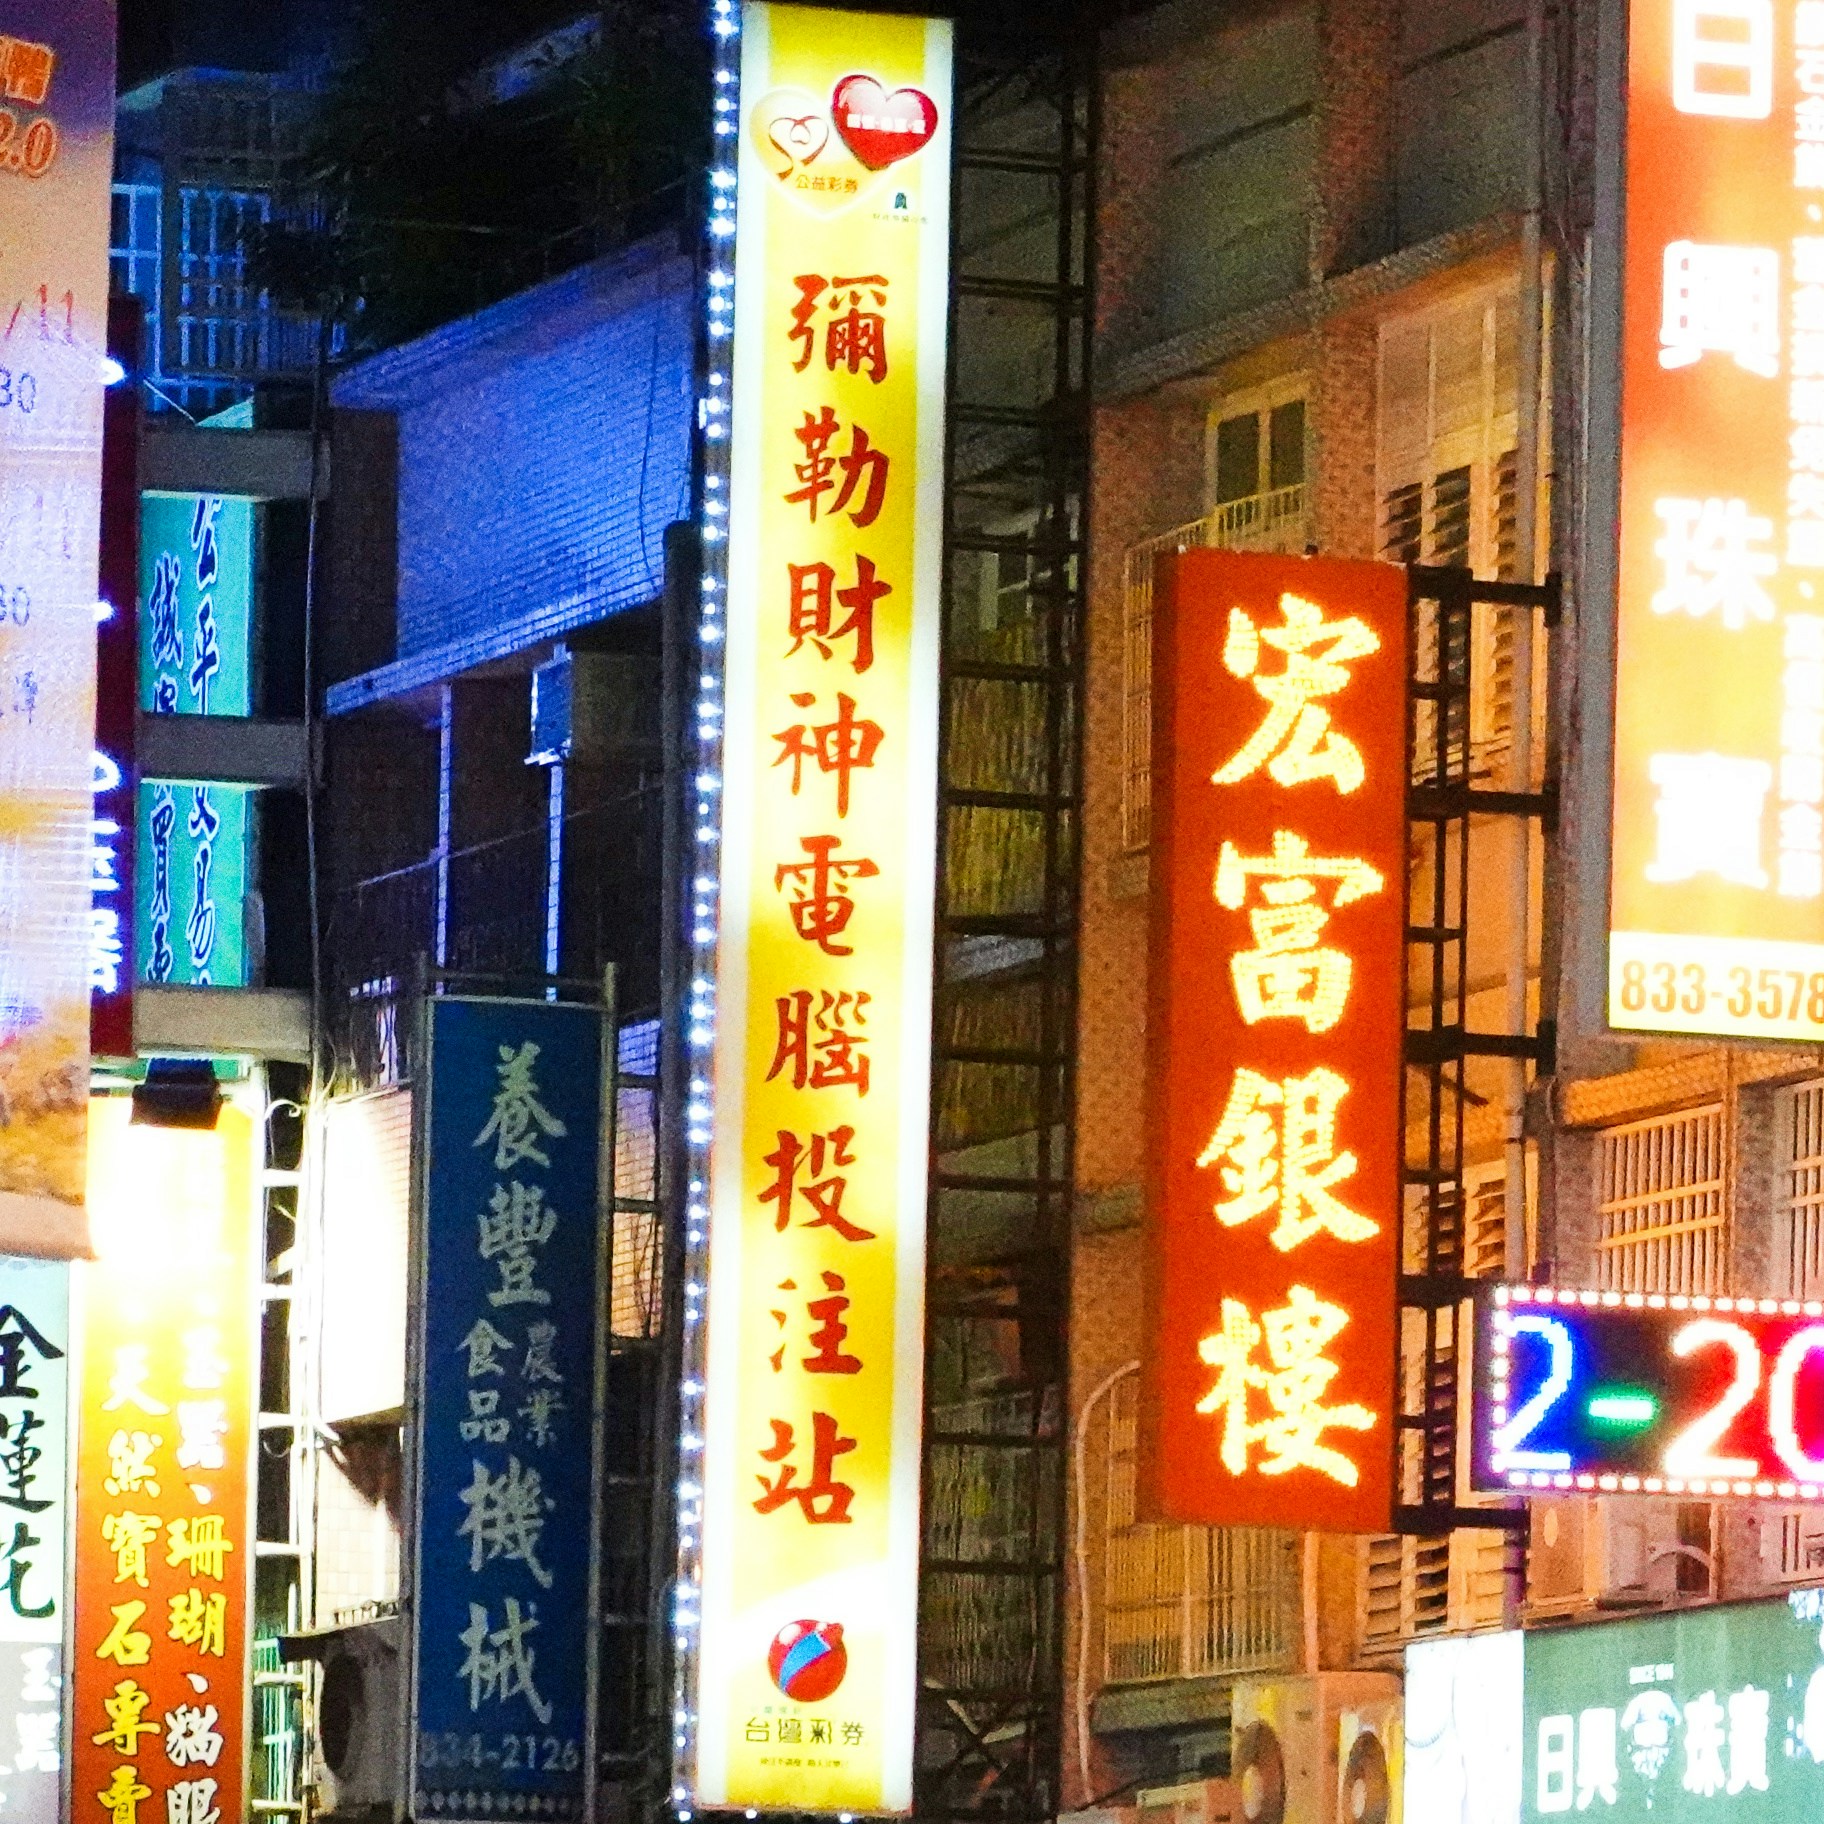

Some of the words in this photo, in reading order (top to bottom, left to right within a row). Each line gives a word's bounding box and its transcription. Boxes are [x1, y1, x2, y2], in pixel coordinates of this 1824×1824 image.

[750, 272, 894, 1528] 彌勒財神電腦投注站
[1196, 591, 1384, 1490] 宏富銀樓
[457, 1454, 555, 1726] 機械
